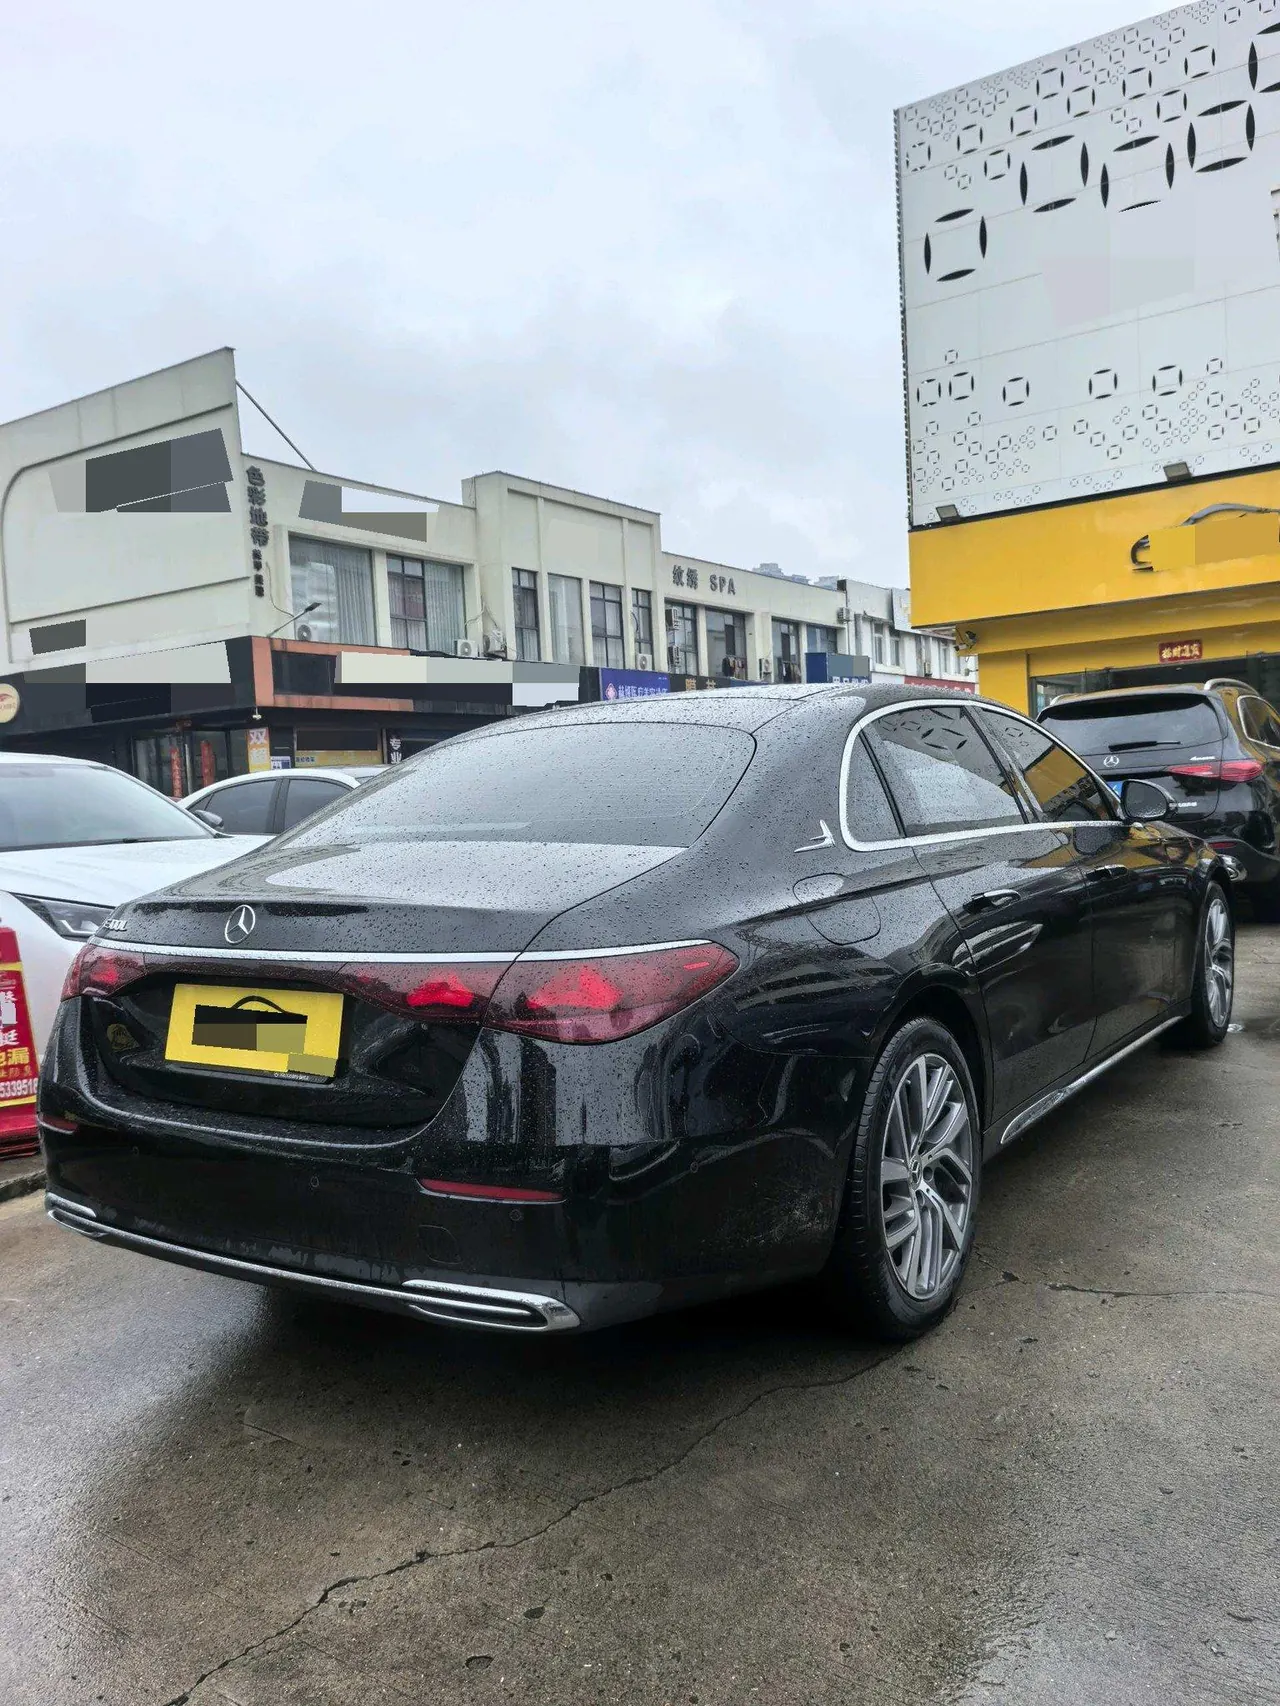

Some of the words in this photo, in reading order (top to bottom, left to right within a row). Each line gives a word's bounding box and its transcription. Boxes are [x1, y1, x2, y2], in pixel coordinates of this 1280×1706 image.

[246, 465, 270, 547] 色彩地带
[673, 565, 698, 590] 纹绣
[709, 574, 736, 595] SPA
[389, 738, 402, 764] 专业
